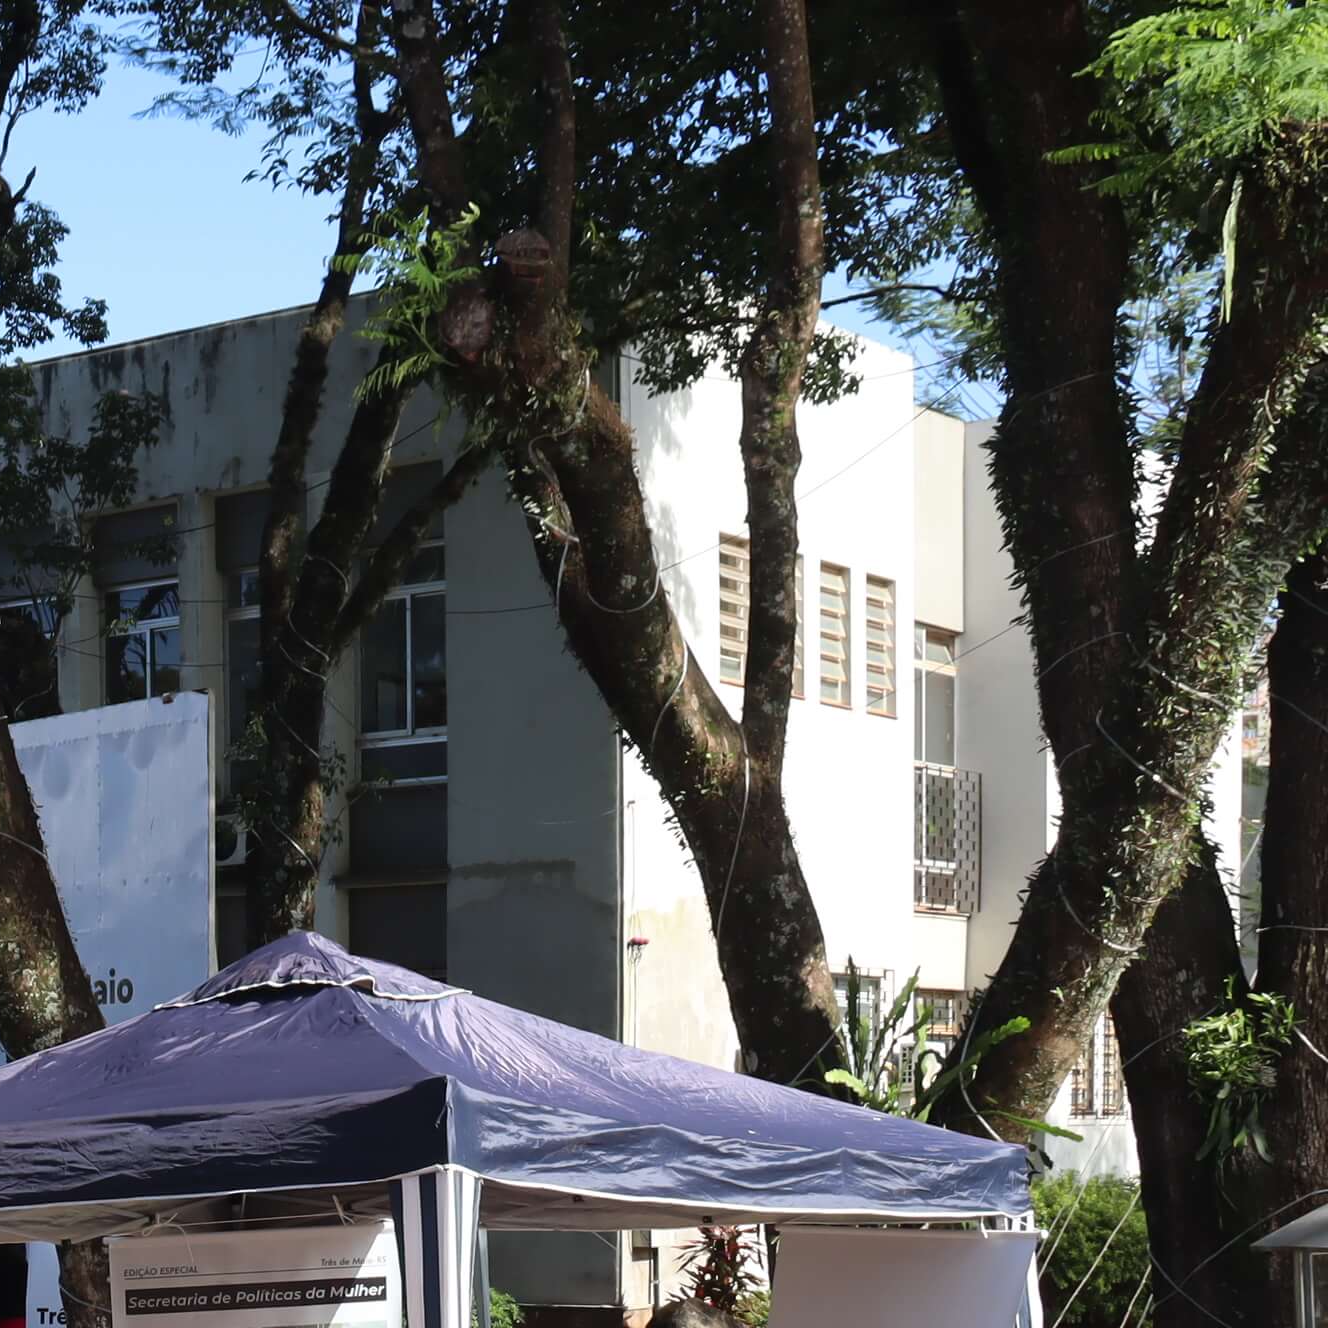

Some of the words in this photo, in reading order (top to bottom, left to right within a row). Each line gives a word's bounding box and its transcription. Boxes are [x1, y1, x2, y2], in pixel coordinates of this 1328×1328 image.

[88, 967, 134, 1004] aio
[127, 1293, 207, 1309] Secretaria
[212, 1291, 231, 1305] de
[236, 1287, 302, 1304] Políticas
[306, 1287, 325, 1300] da
[330, 1283, 385, 1299] Mulher
[36, 1307, 67, 1325] Trê
